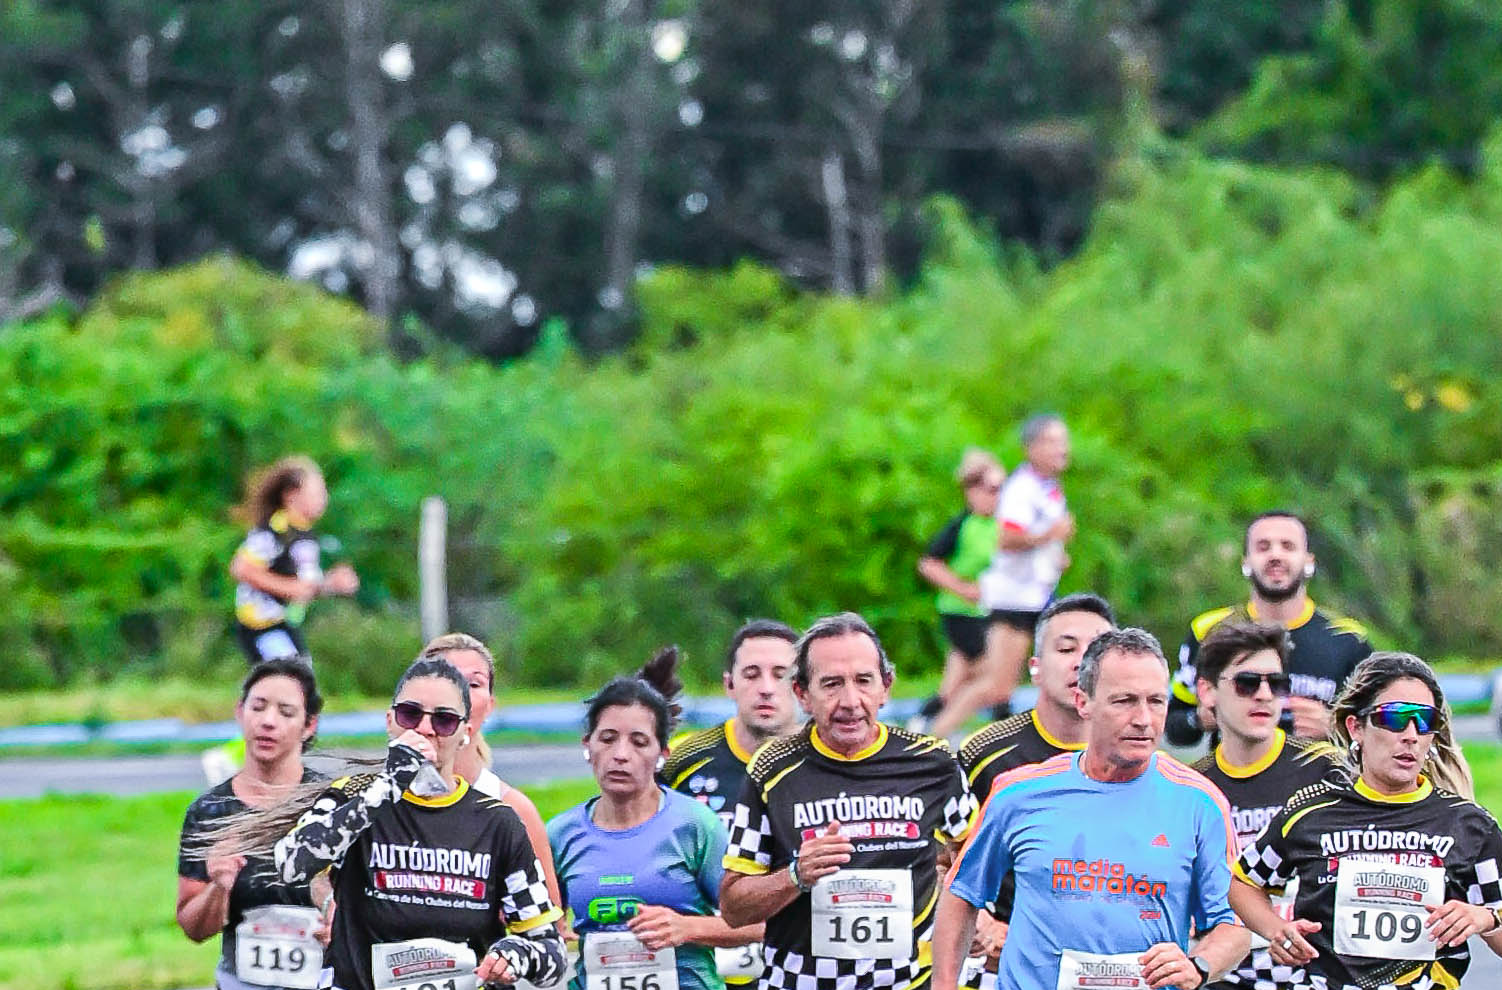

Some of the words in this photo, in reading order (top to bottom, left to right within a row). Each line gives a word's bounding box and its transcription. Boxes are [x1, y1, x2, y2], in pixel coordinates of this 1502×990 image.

[794, 792, 925, 829] AUTÓDROMO
[875, 821, 908, 838] RACE
[1320, 823, 1455, 859] AUTÓDROMO
[369, 840, 492, 880] AUTÓDROMO
[1052, 858, 1125, 878] media
[385, 874, 442, 891] RUNNING
[444, 877, 476, 898] RACE
[1052, 873, 1168, 899] maratón
[1353, 868, 1430, 893] AUTÓDROMO
[828, 916, 895, 943] 161
[1351, 910, 1422, 944] 109
[250, 945, 305, 972] 119
